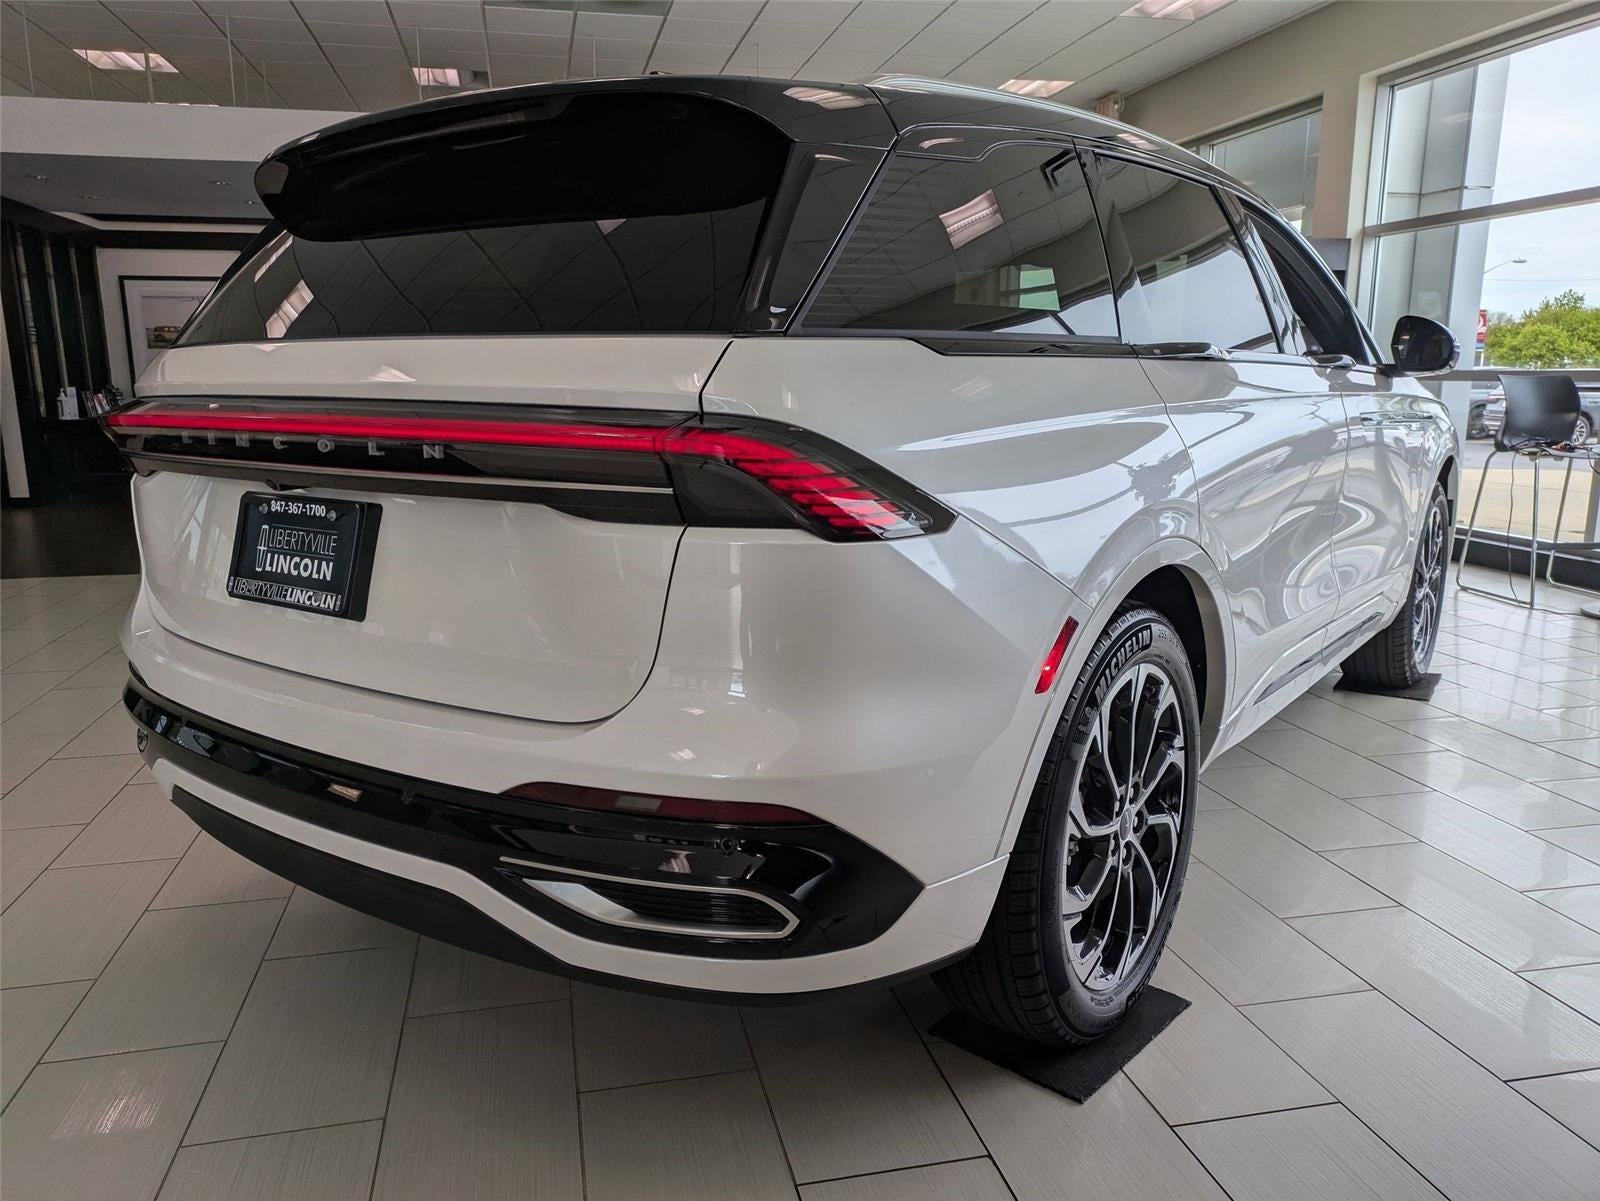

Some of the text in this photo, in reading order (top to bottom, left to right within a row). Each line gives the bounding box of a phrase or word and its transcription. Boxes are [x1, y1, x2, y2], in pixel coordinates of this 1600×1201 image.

[181, 431, 445, 459] LINCOLN
[271, 500, 326, 517] 847-367-1700
[269, 528, 338, 556] LIBERTYVILLE
[265, 553, 333, 581] LINCOLN
[1094, 628, 1151, 702] MICHELIN
